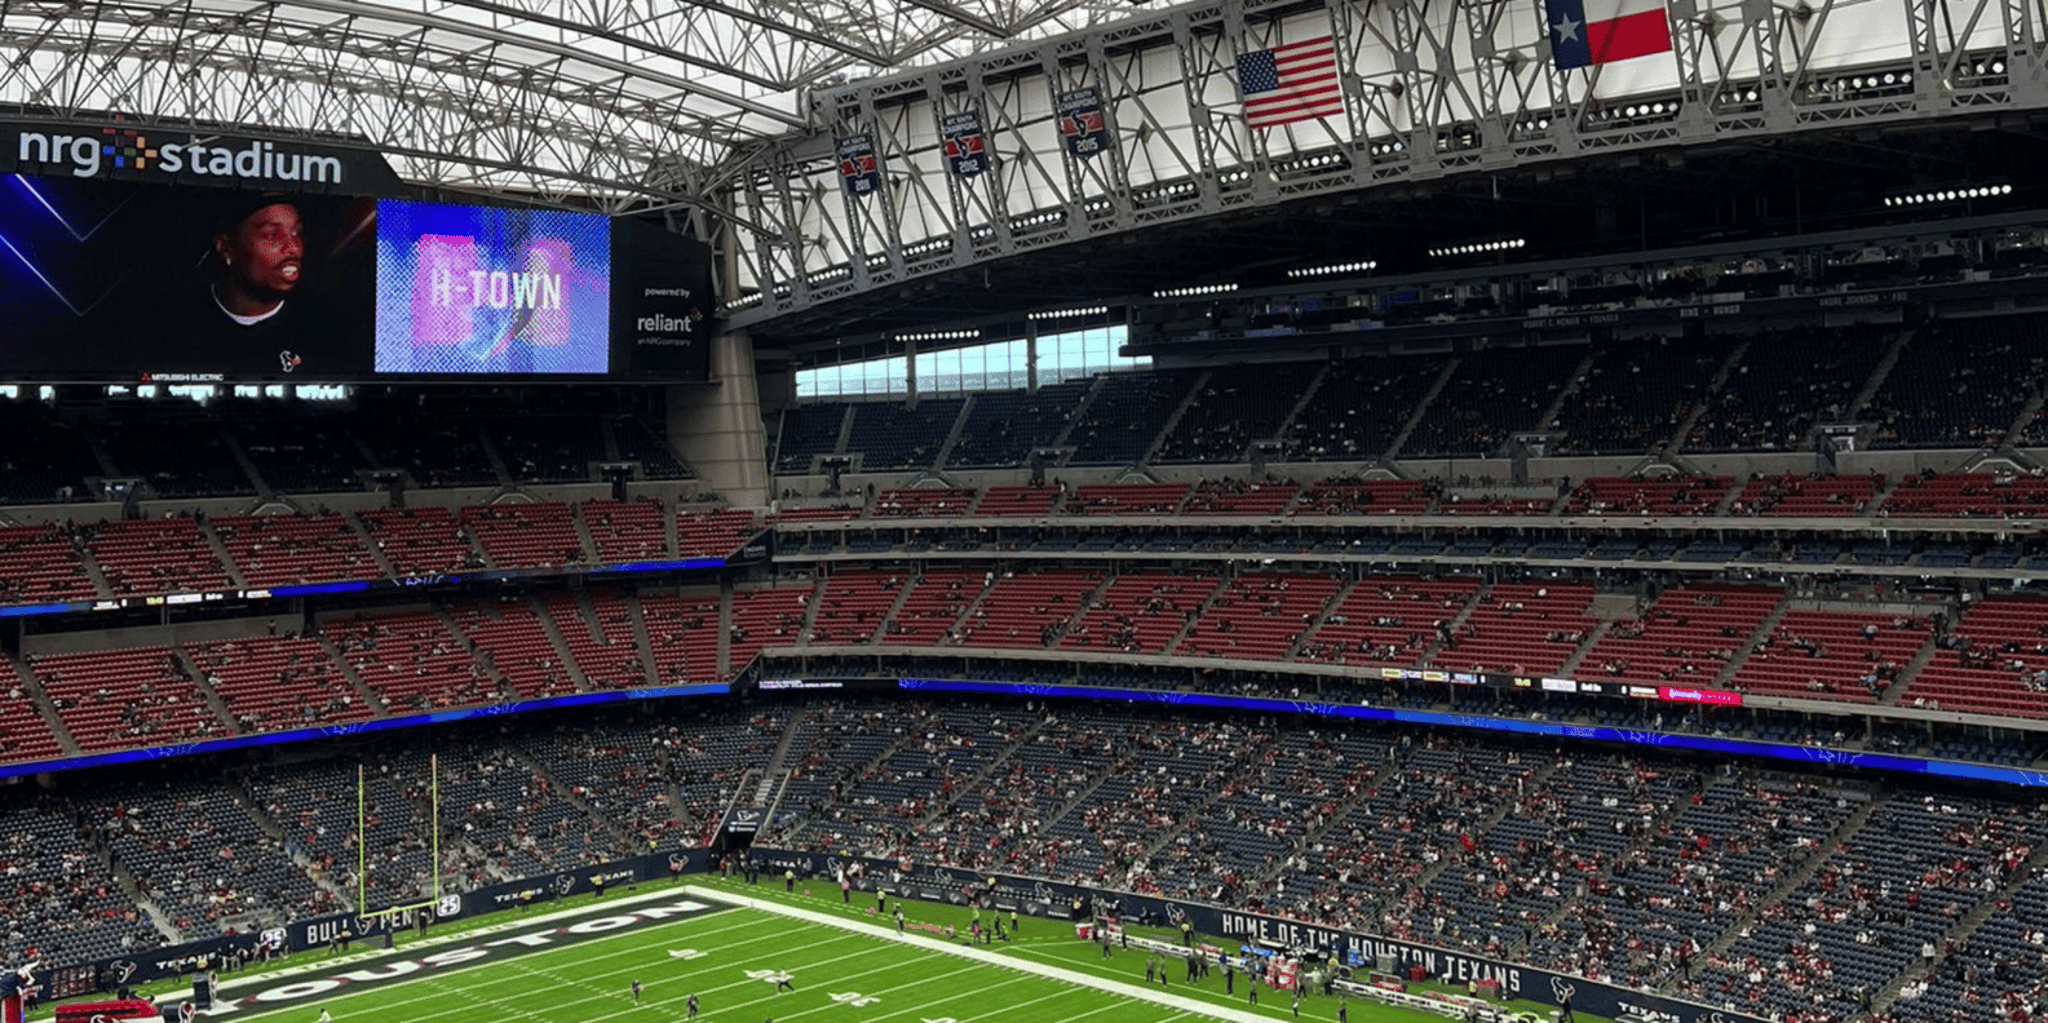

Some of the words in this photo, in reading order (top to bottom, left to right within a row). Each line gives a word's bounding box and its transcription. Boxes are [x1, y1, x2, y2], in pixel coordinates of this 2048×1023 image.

[1076, 137, 1099, 153] 2015
[19, 132, 100, 177] nrg
[159, 141, 341, 183] stadium
[958, 159, 979, 173] 2012
[432, 269, 562, 310] H-TOWN
[644, 287, 679, 297] powered
[680, 289, 690, 299] by
[637, 313, 692, 332] reliant
[1222, 914, 1268, 940] HOME
[1278, 923, 1298, 945] OF
